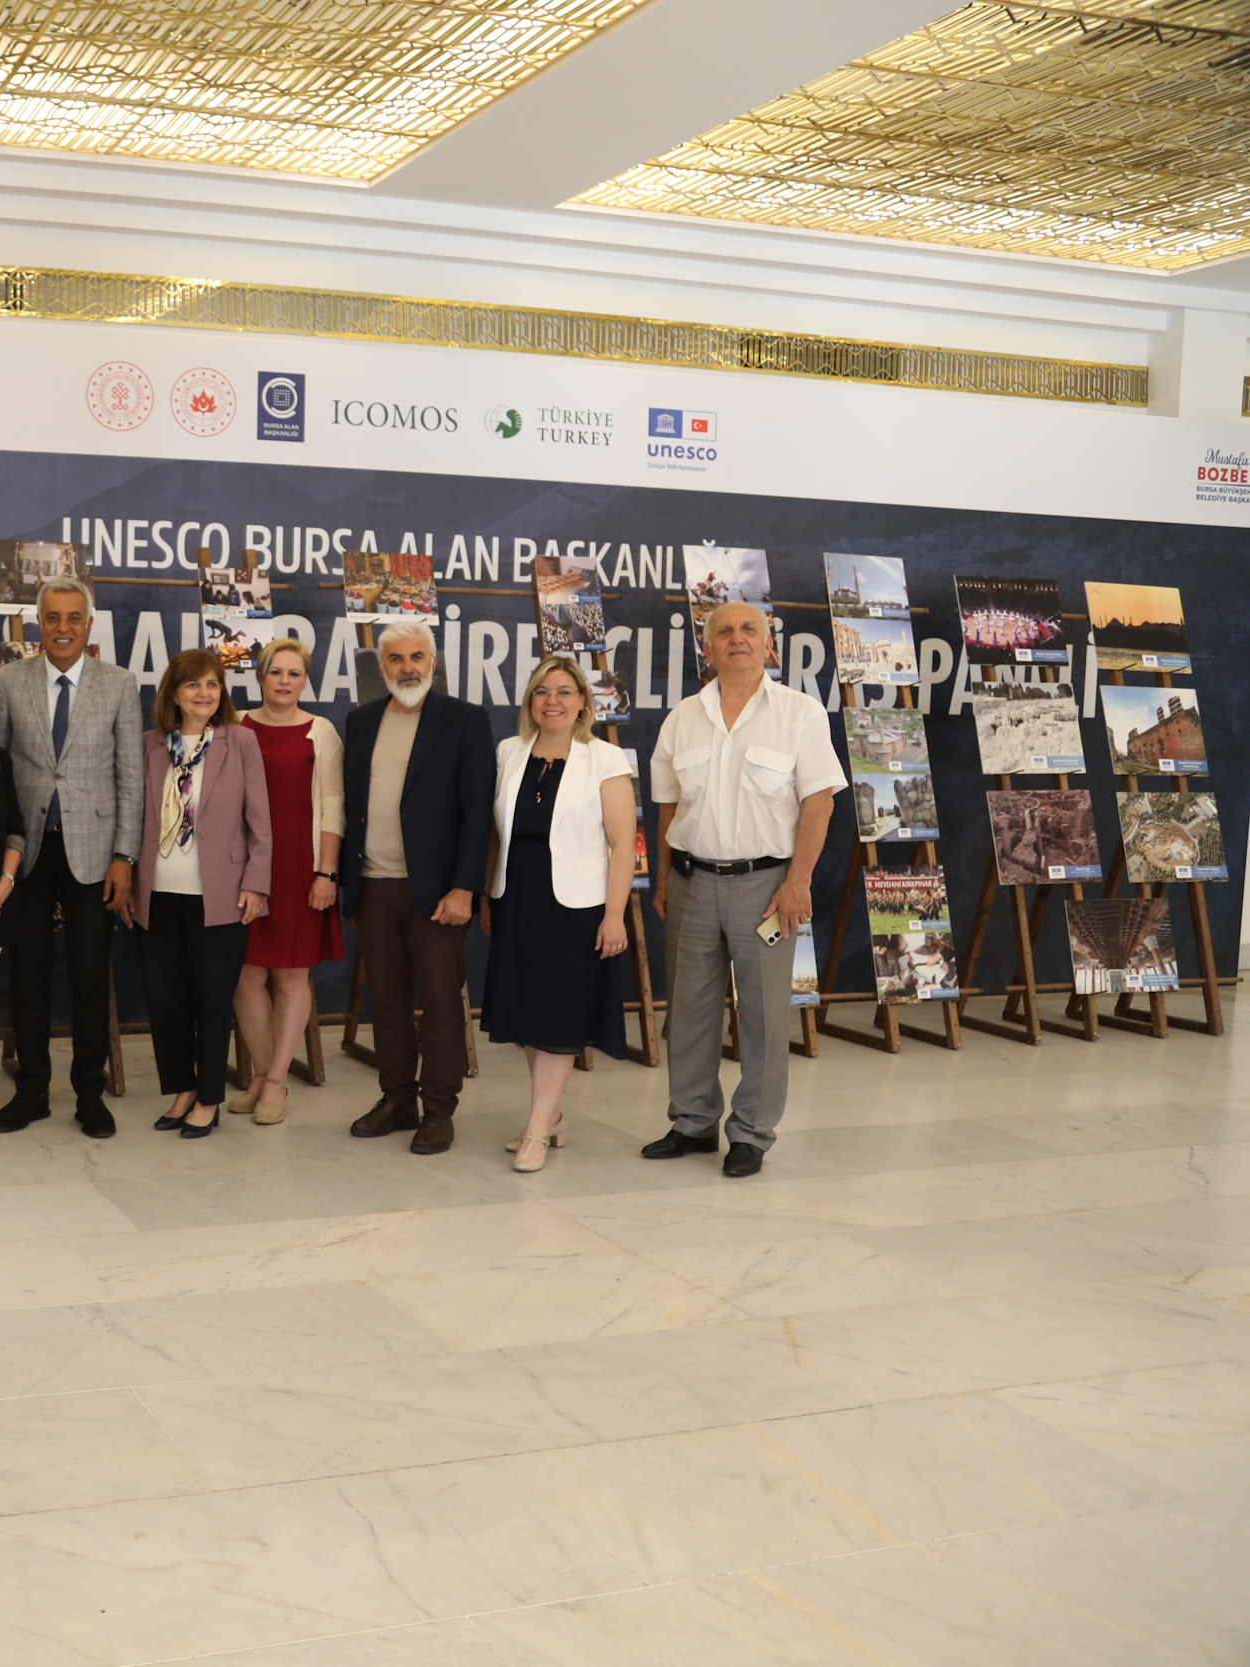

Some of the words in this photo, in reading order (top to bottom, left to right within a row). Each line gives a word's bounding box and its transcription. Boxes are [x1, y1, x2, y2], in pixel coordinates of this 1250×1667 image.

[332, 400, 458, 432] ICOMOS
[538, 406, 614, 428] TÜRKİYE
[263, 422, 284, 430] BURSA
[284, 423, 299, 431] ALAN
[537, 428, 614, 447] TURKEY
[647, 443, 717, 462] unesco
[1204, 448, 1249, 470] Mustafa
[647, 462, 666, 470] Türkiye
[1197, 466, 1250, 483] BOZBE
[1196, 485, 1217, 493] BURSA
[1196, 493, 1227, 502] BELEDİYE
[63, 517, 230, 570] UNESCO
[514, 537, 716, 590] BKANL
